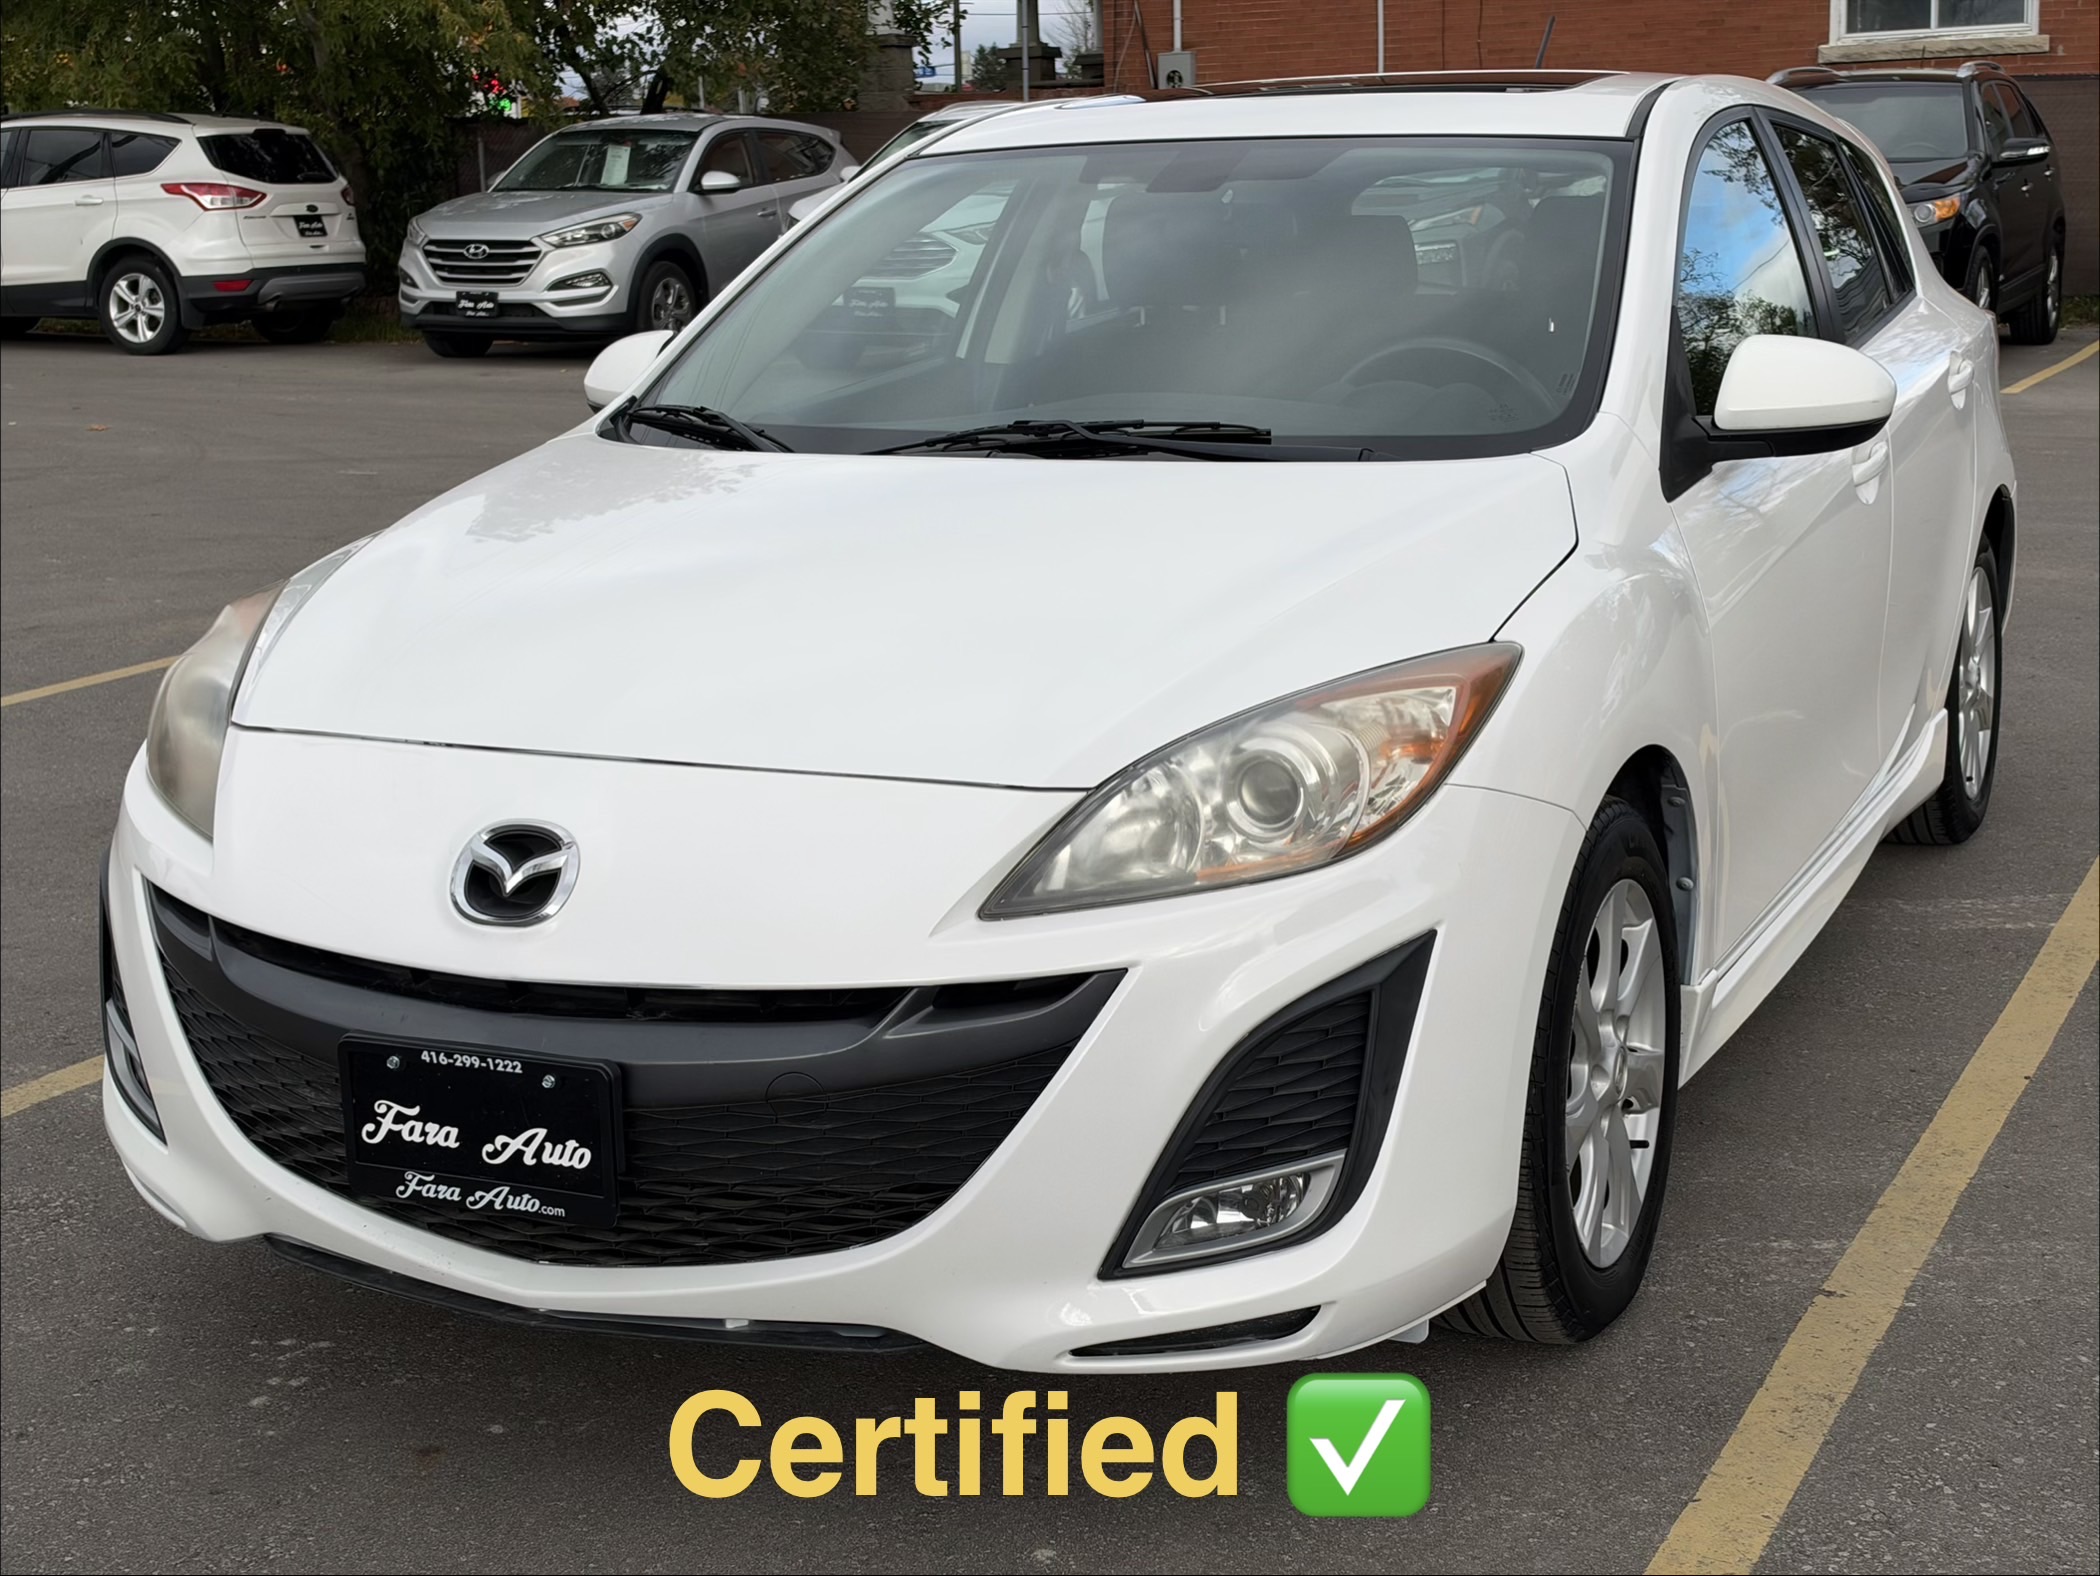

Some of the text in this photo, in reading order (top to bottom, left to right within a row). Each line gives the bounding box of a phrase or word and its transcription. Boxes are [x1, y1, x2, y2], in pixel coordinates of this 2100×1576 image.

[420, 1050, 523, 1074] 416-299-1222
[361, 1099, 592, 1170] Fara Auto
[395, 1170, 462, 1199] Fara
